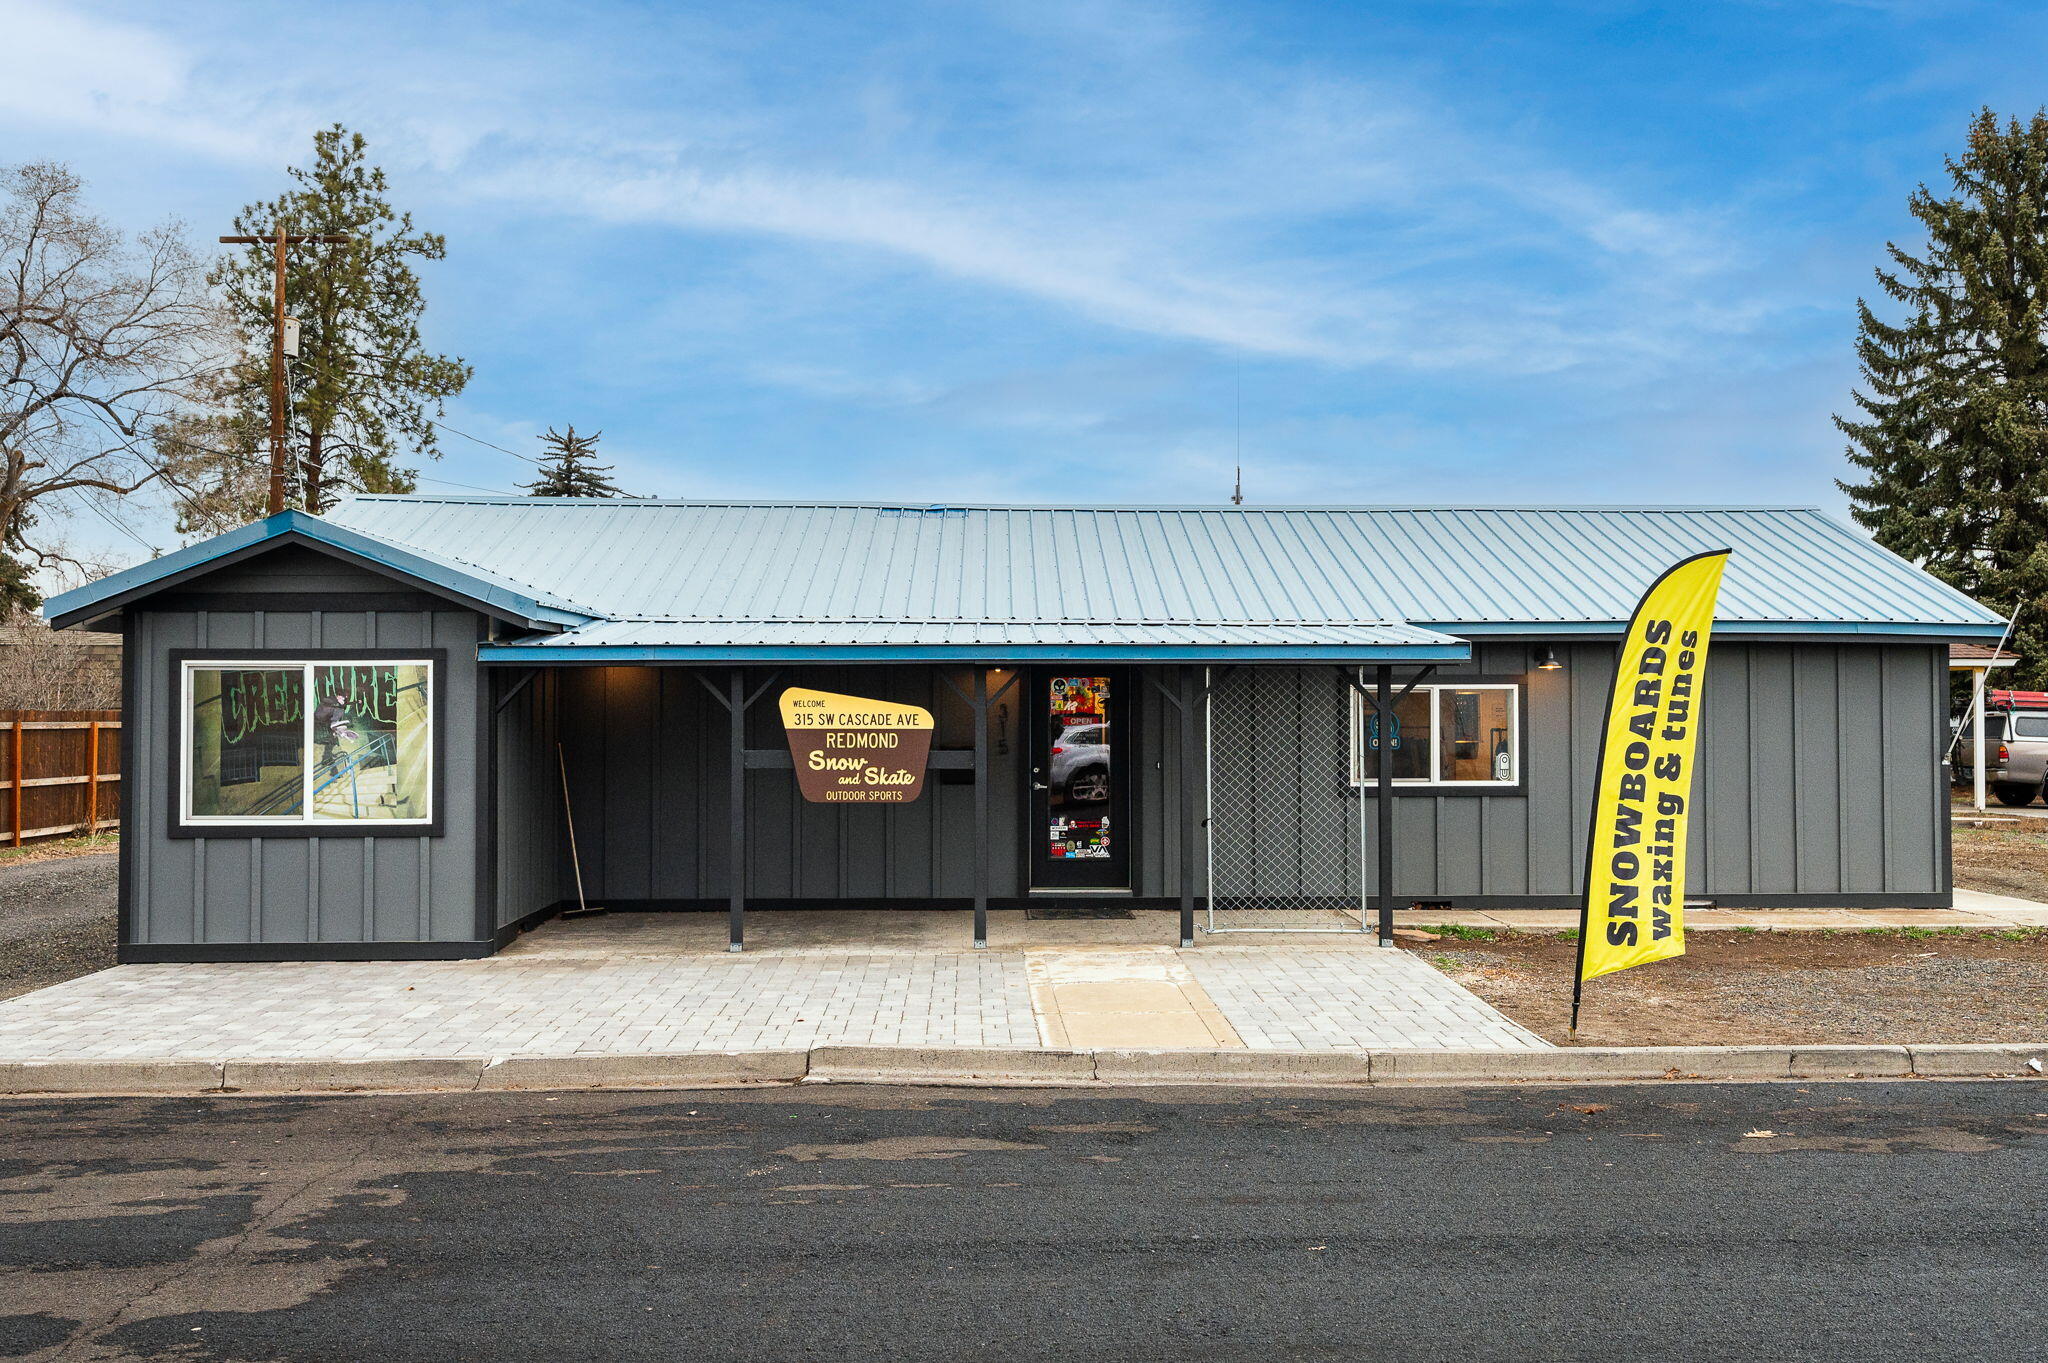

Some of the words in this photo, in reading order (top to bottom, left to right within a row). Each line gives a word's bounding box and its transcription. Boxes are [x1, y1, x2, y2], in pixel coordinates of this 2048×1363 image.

[1661, 630, 1699, 742] tunes
[793, 700, 826, 708] WELCOME
[794, 713, 814, 726] 315
[818, 713, 835, 726] SW
[838, 713, 892, 726] CASCADE
[897, 713, 920, 726] AVE
[1070, 717, 1093, 725] OPEN
[826, 732, 899, 749] REDMOND
[808, 750, 868, 771] Snow
[1654, 753, 1683, 783] &
[838, 773, 861, 785] and
[864, 767, 916, 786] Skate
[1606, 619, 1673, 948] SNOWBOARDS
[826, 790, 866, 801] OUTDOOR
[868, 790, 903, 801] SPORTS
[1647, 791, 1685, 942] waxing
